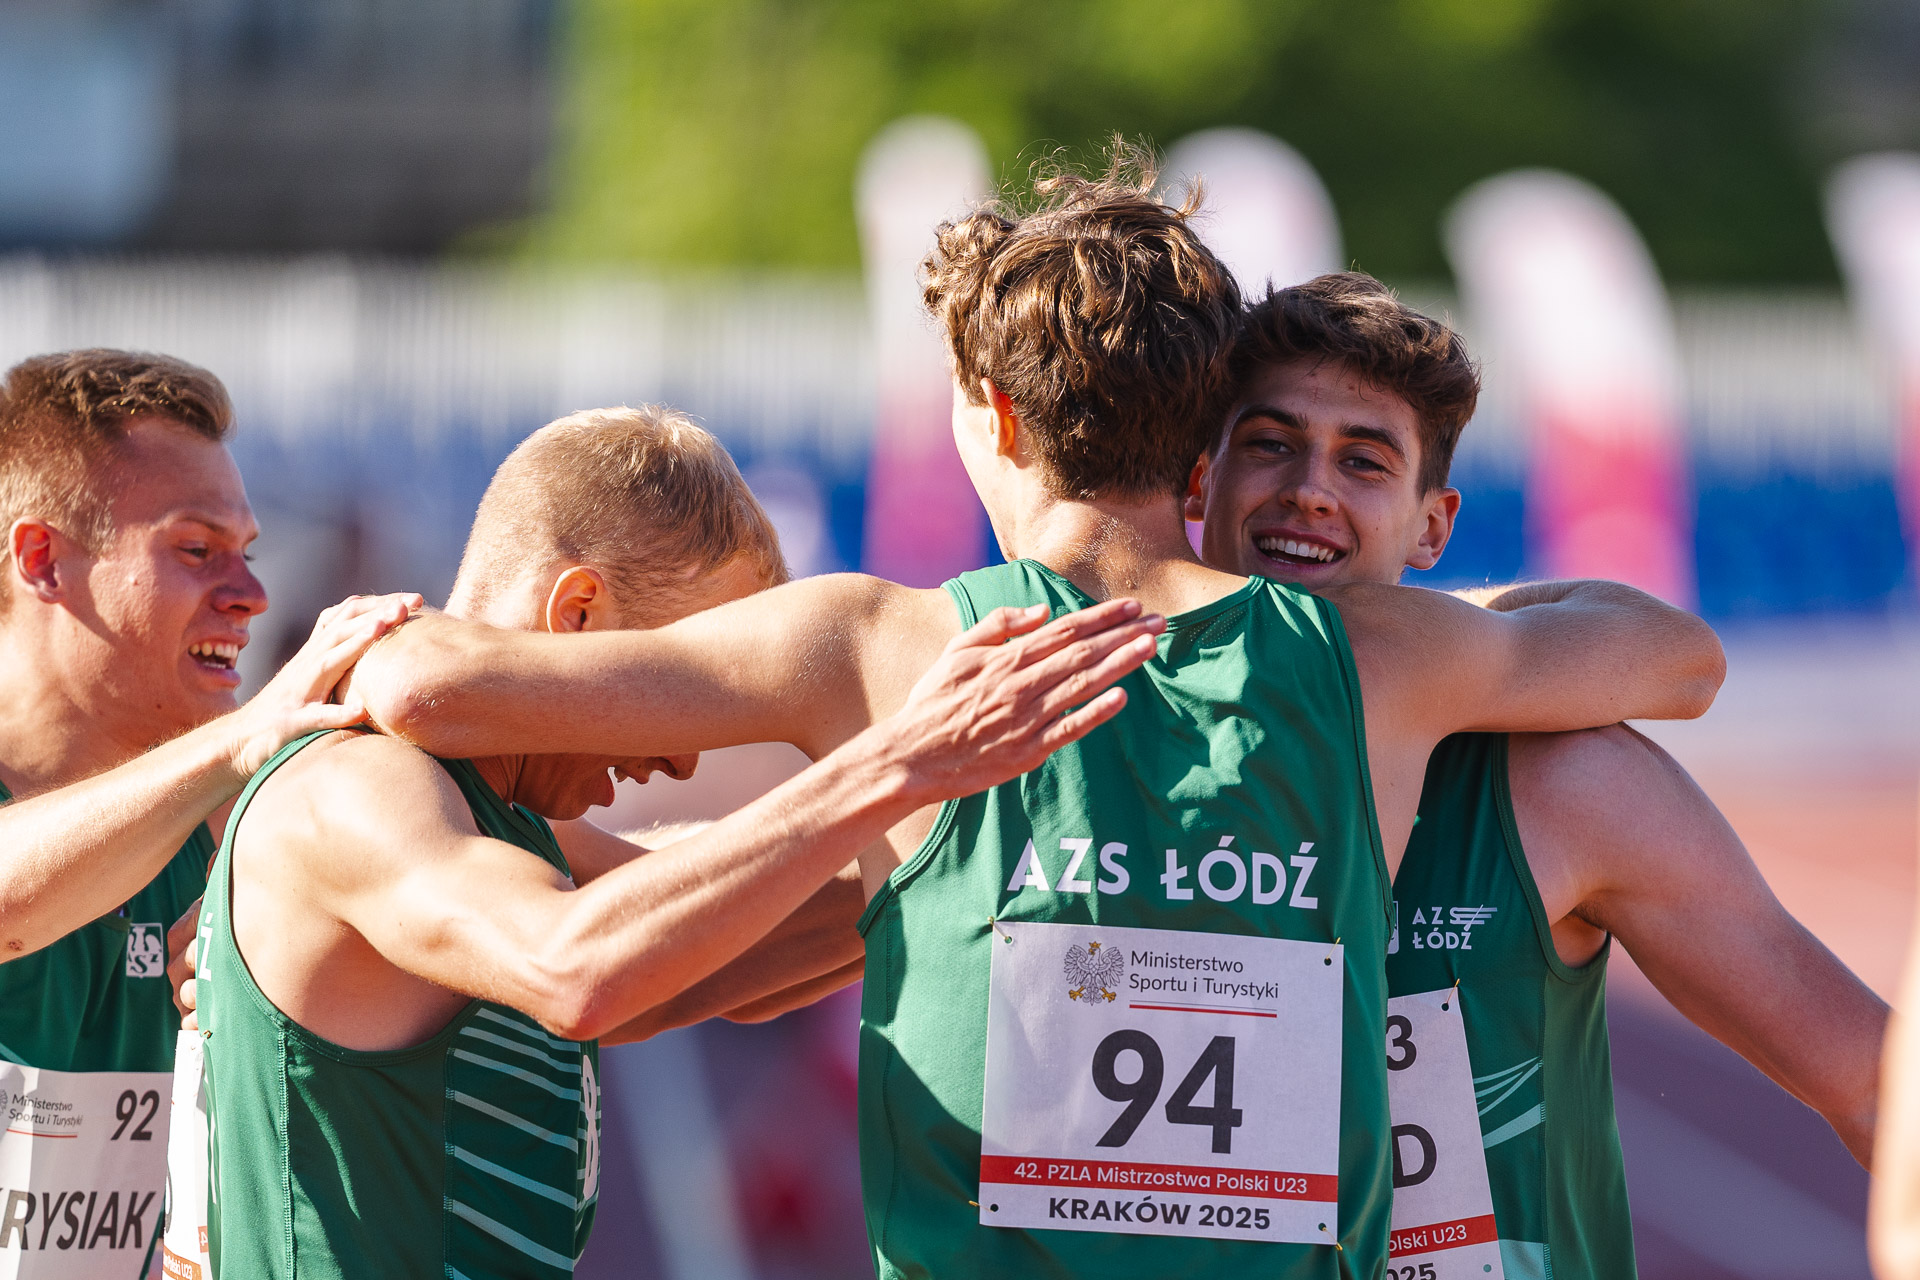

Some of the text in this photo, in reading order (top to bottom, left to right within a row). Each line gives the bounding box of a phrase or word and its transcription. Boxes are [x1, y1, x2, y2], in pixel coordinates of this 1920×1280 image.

[1006, 835, 1319, 909] AZS ŁÓDŹ
[1412, 905, 1497, 925] AZS
[1412, 927, 1472, 950] ŁÓDŹ
[1131, 950, 1244, 974] Ministerstwo
[1129, 973, 1279, 1000] Sportu i Turystyki
[1386, 1014, 1417, 1072] 3
[12, 1093, 73, 1112] Ministerstwo
[1091, 1029, 1243, 1154] 94
[8, 1108, 45, 1124] Sportu
[53, 1114, 84, 1128] Turystyki
[110, 1089, 160, 1141] 92
[1391, 1123, 1438, 1189] D
[1014, 1162, 1308, 1194] 42. PZLA Mistrzostwa Polski U23
[0, 1188, 156, 1251] RYSIAK
[1049, 1195, 1271, 1230] KRAKÓW 2025
[1389, 1224, 1467, 1252] olski U23
